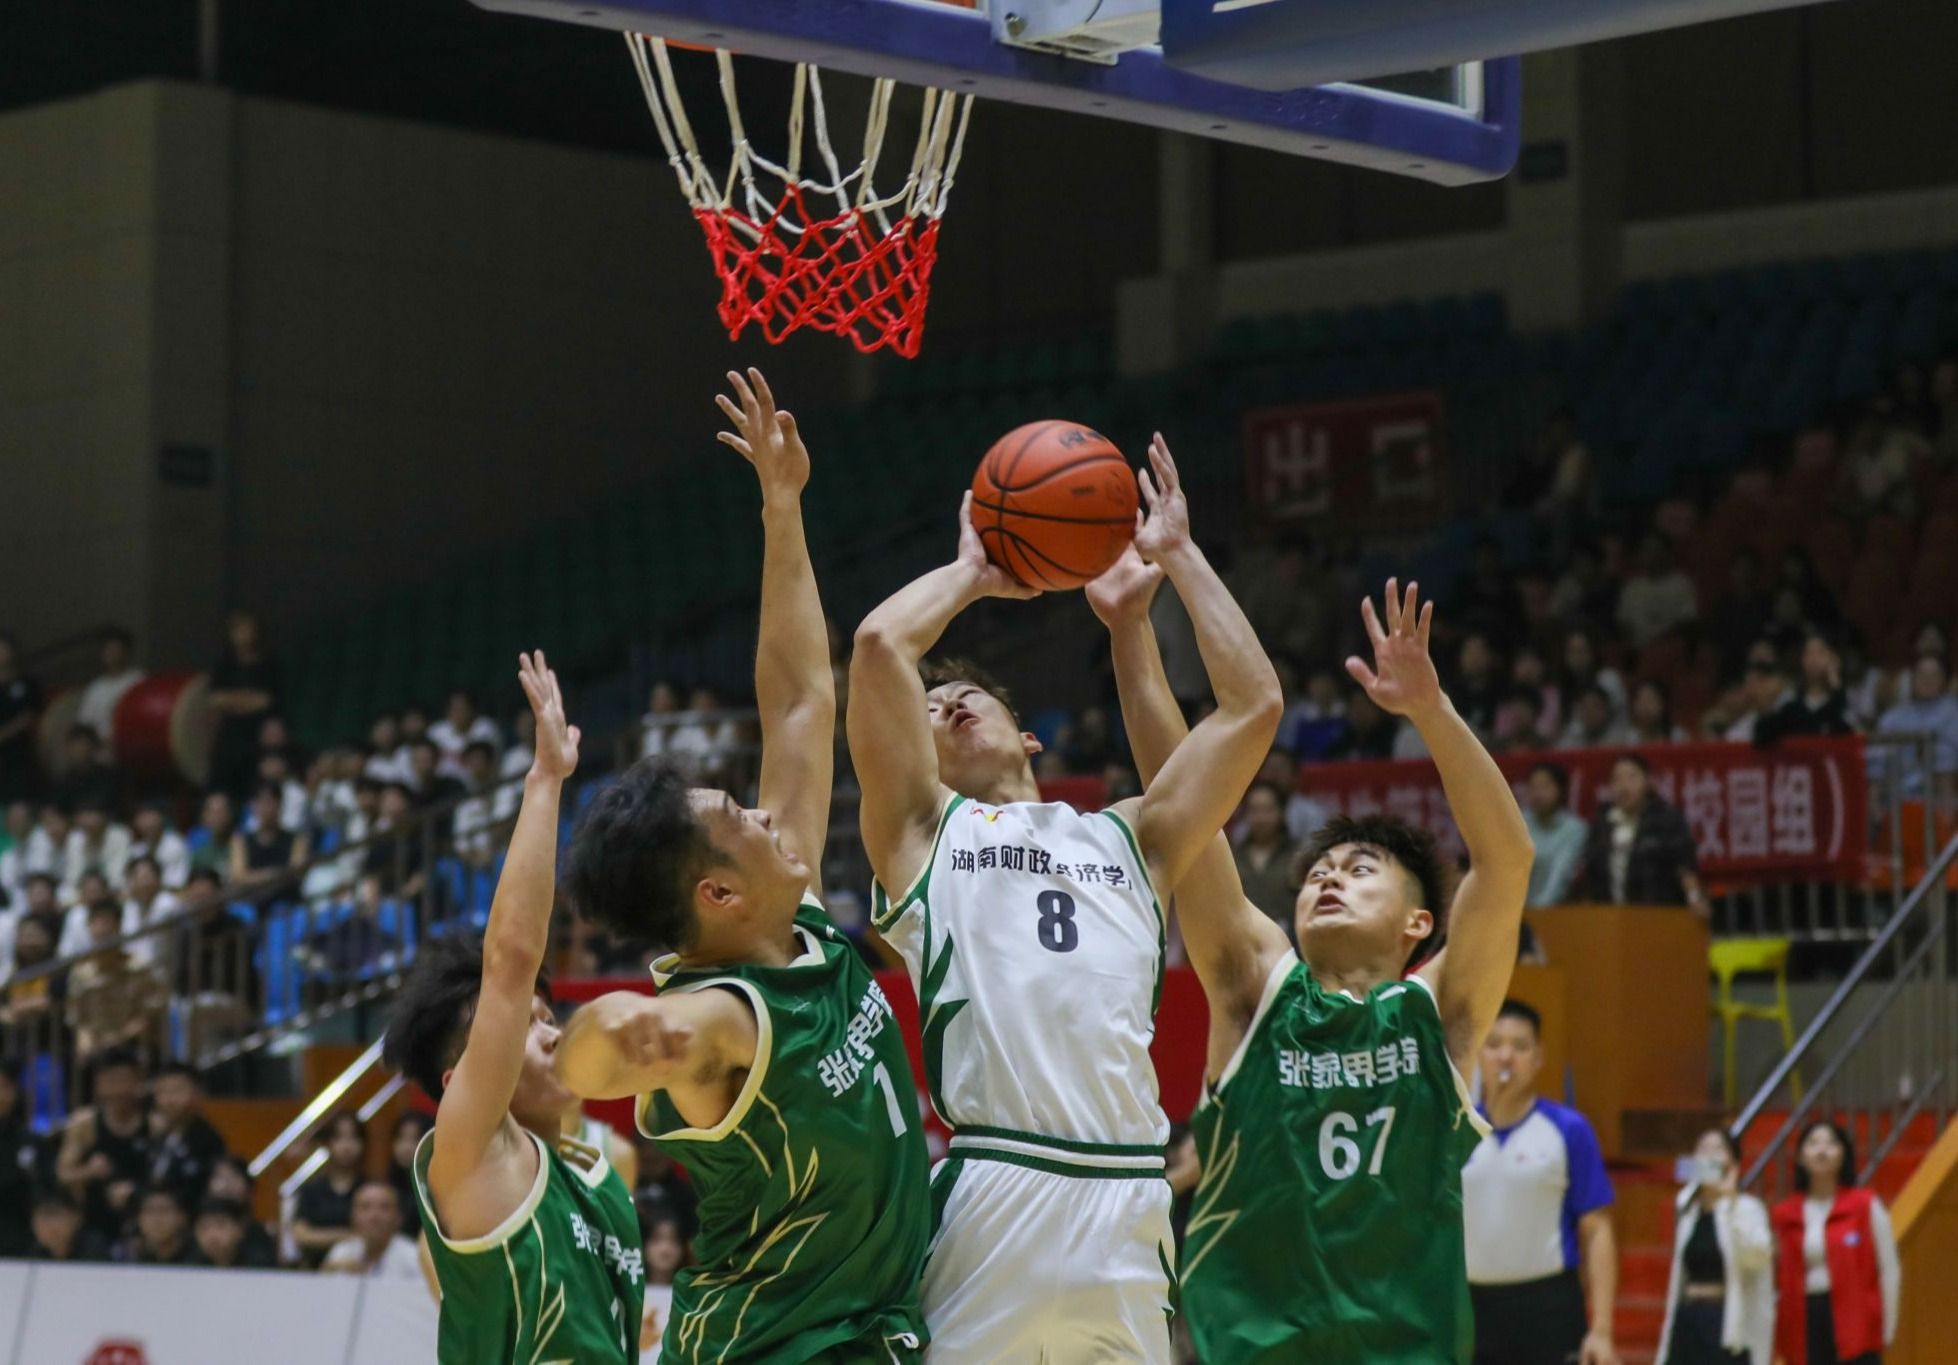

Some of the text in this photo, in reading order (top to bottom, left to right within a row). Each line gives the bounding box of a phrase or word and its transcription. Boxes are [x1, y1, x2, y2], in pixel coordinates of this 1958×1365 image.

[951, 847, 1132, 890] 湖南财政济学
[1037, 890, 1078, 952] 8
[873, 1061, 907, 1138] 1
[1318, 1106, 1396, 1180] 67
